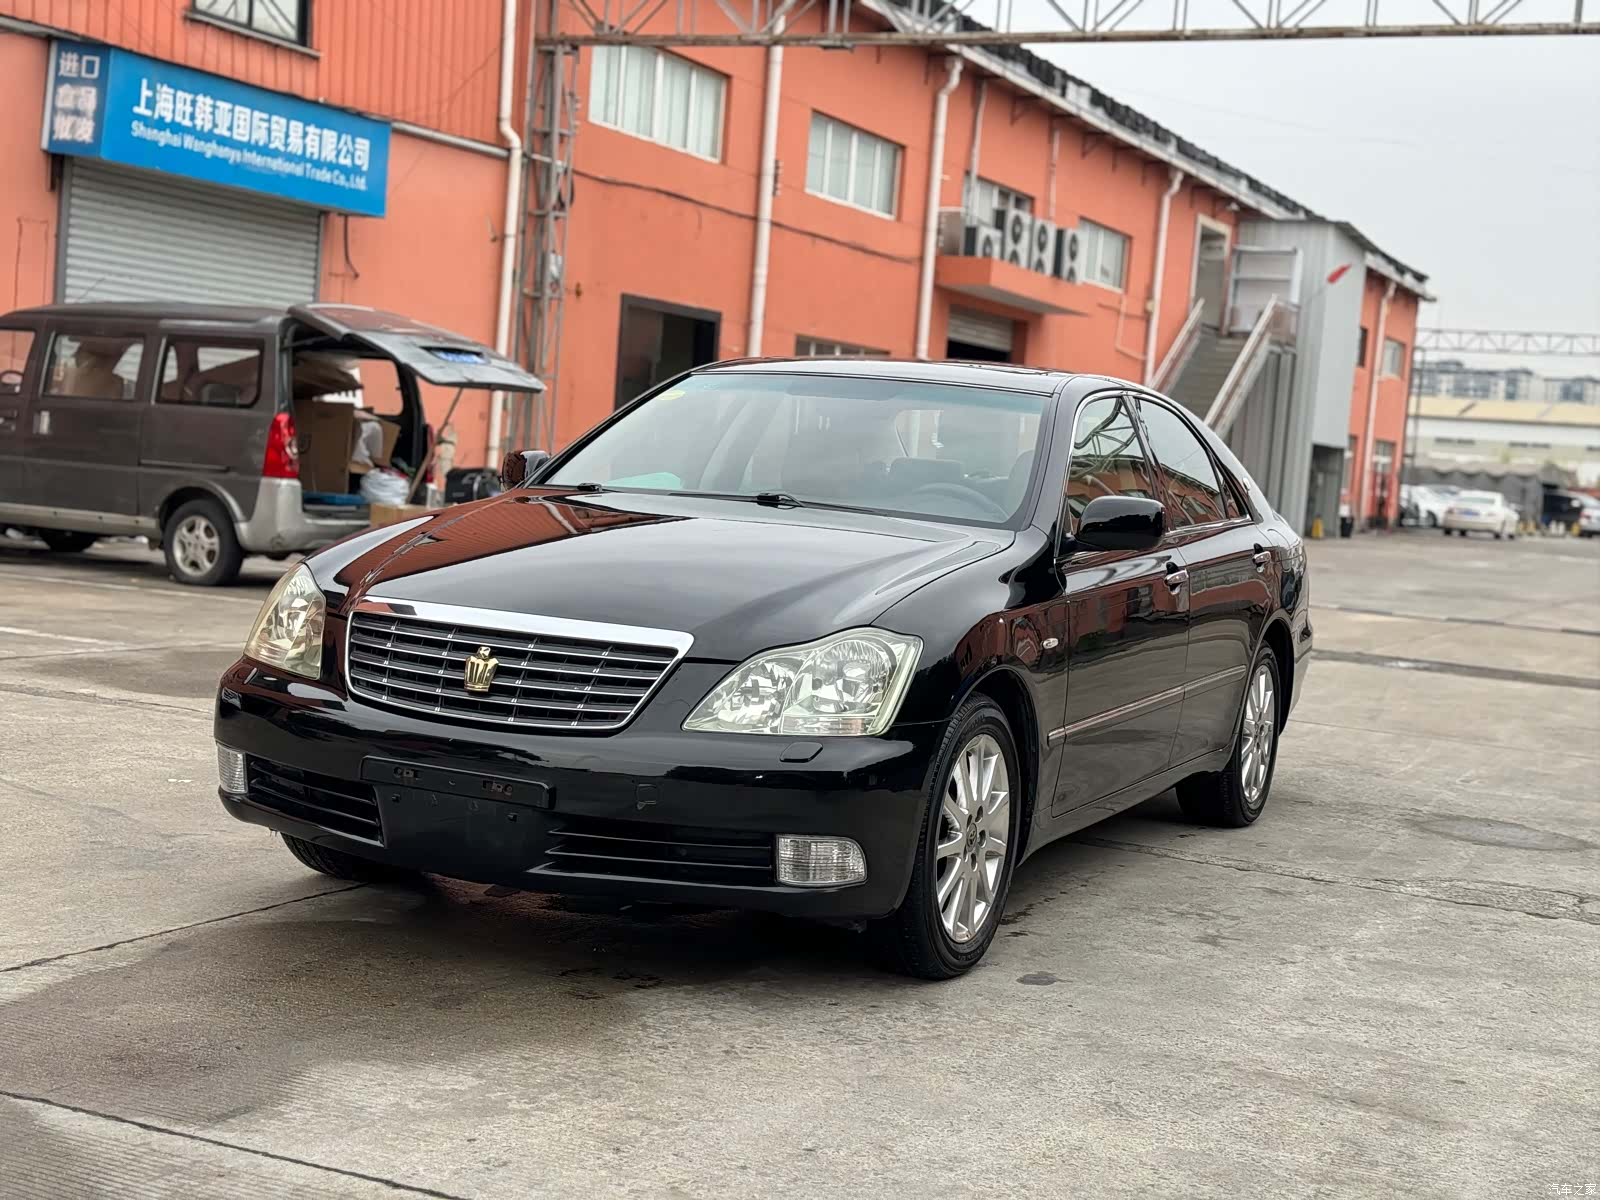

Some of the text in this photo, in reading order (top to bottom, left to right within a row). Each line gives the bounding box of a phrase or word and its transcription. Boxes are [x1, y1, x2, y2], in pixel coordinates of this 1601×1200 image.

[58, 51, 100, 79] 进口
[131, 119, 182, 147] Shanghai
[241, 148, 305, 178] International
[132, 77, 370, 171] 上海旺韩亚国际贸易有限公司
